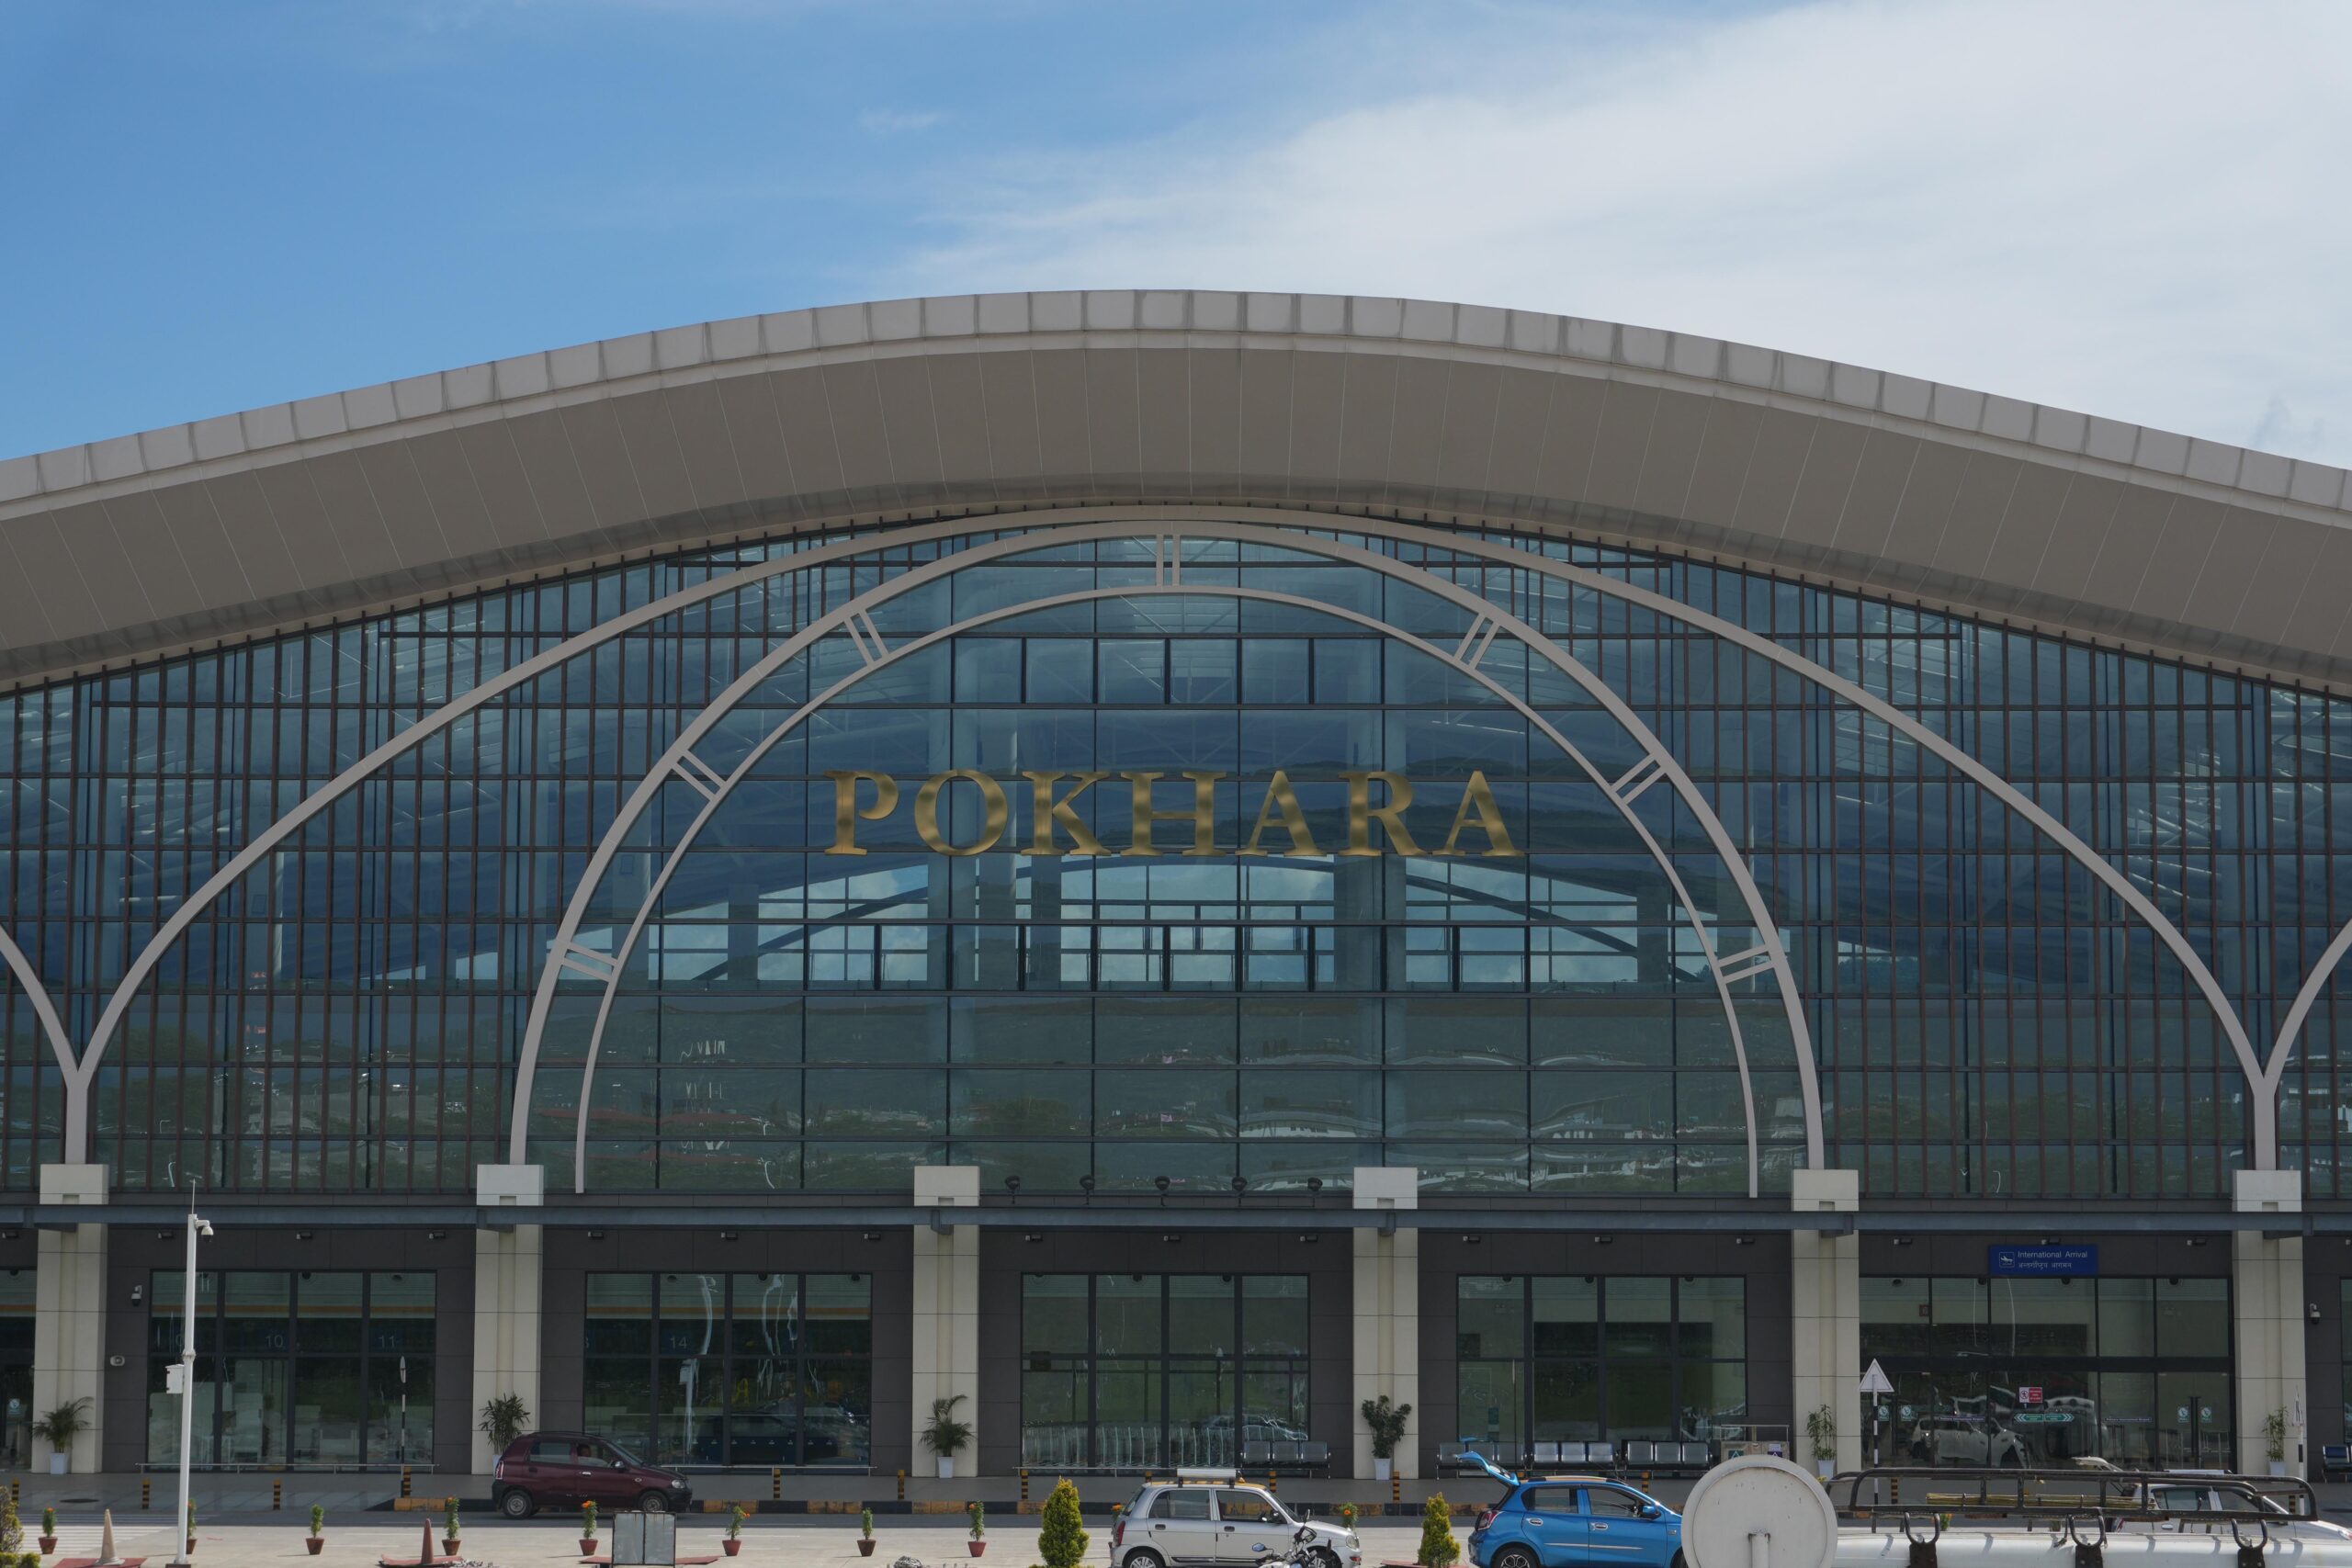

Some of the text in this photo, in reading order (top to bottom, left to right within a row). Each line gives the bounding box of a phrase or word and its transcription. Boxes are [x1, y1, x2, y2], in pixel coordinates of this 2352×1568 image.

[823, 770, 1525, 856] POKHARA
[265, 1335, 284, 1348] 10
[378, 1335, 395, 1348] 11
[670, 1336, 687, 1348] 14
